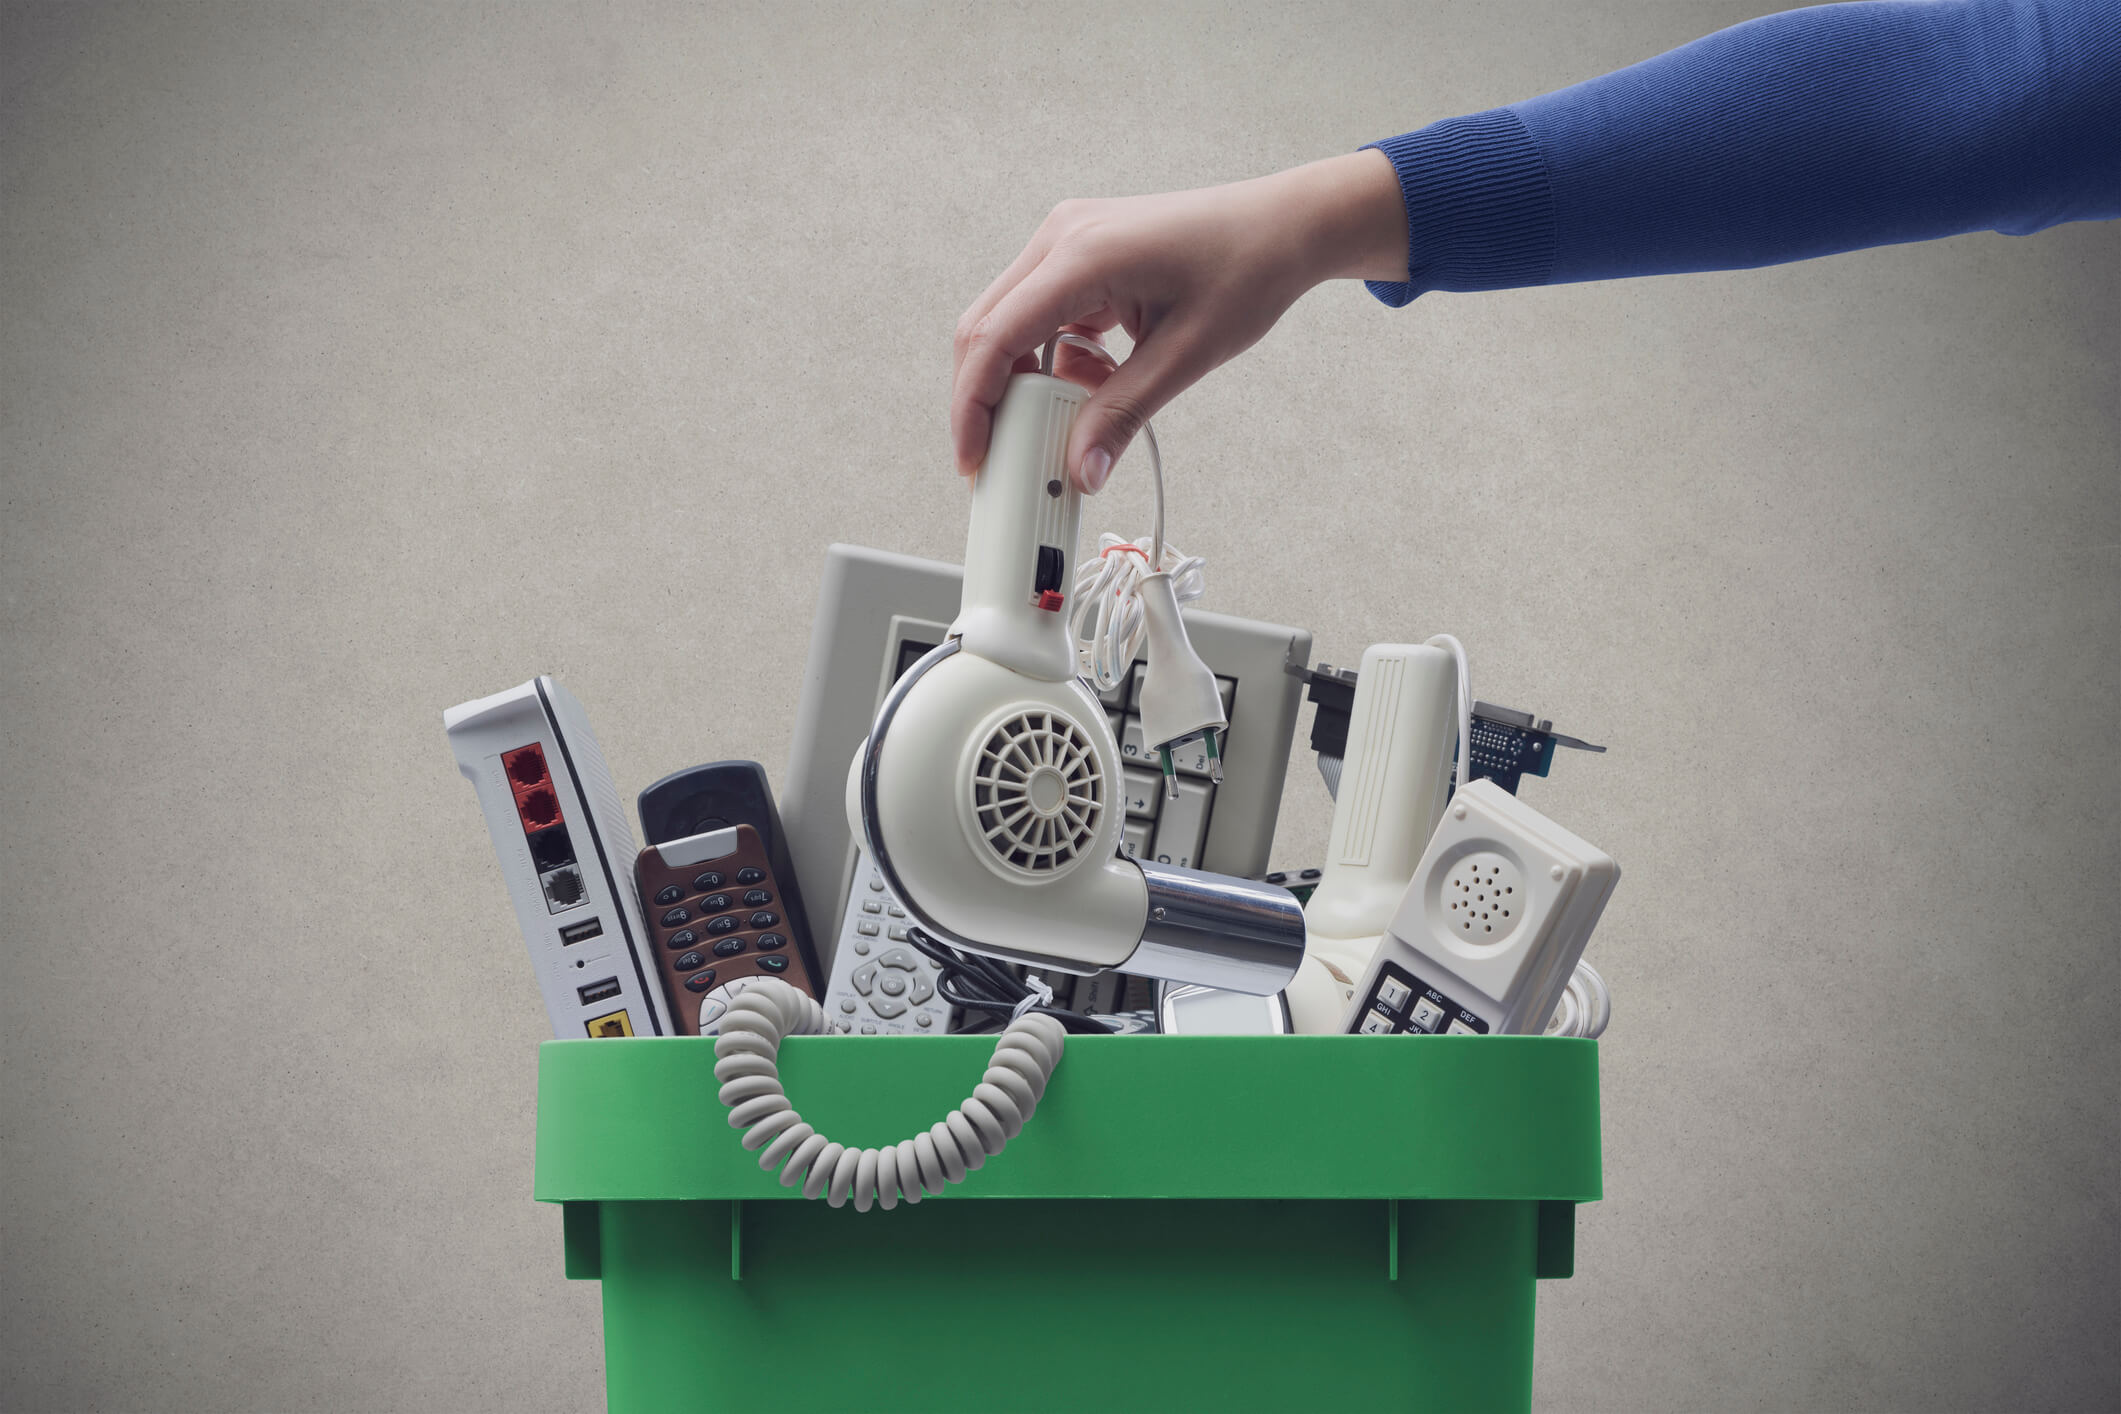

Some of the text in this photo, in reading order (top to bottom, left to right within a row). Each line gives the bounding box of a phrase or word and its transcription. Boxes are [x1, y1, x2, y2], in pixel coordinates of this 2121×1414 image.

[1124, 744, 1137, 756] 3
[1196, 754, 1205, 770] Del
[1128, 842, 1136, 858] nd
[711, 875, 718, 884] 0
[717, 897, 725, 906] 8
[762, 892, 768, 901] 7
[679, 911, 687, 920] 9
[766, 914, 772, 923] 4
[724, 919, 731, 928] 5
[685, 932, 693, 941] 6
[773, 936, 779, 945] 1
[731, 940, 739, 950] 2
[690, 954, 698, 964] 3
[1389, 988, 1395, 999] 1
[1426, 989, 1443, 1003] ABC
[1376, 1002, 1391, 1016] GHI
[1420, 1010, 1429, 1021] 2
[1460, 1010, 1477, 1024] DEF
[1369, 1023, 1378, 1033] 4
